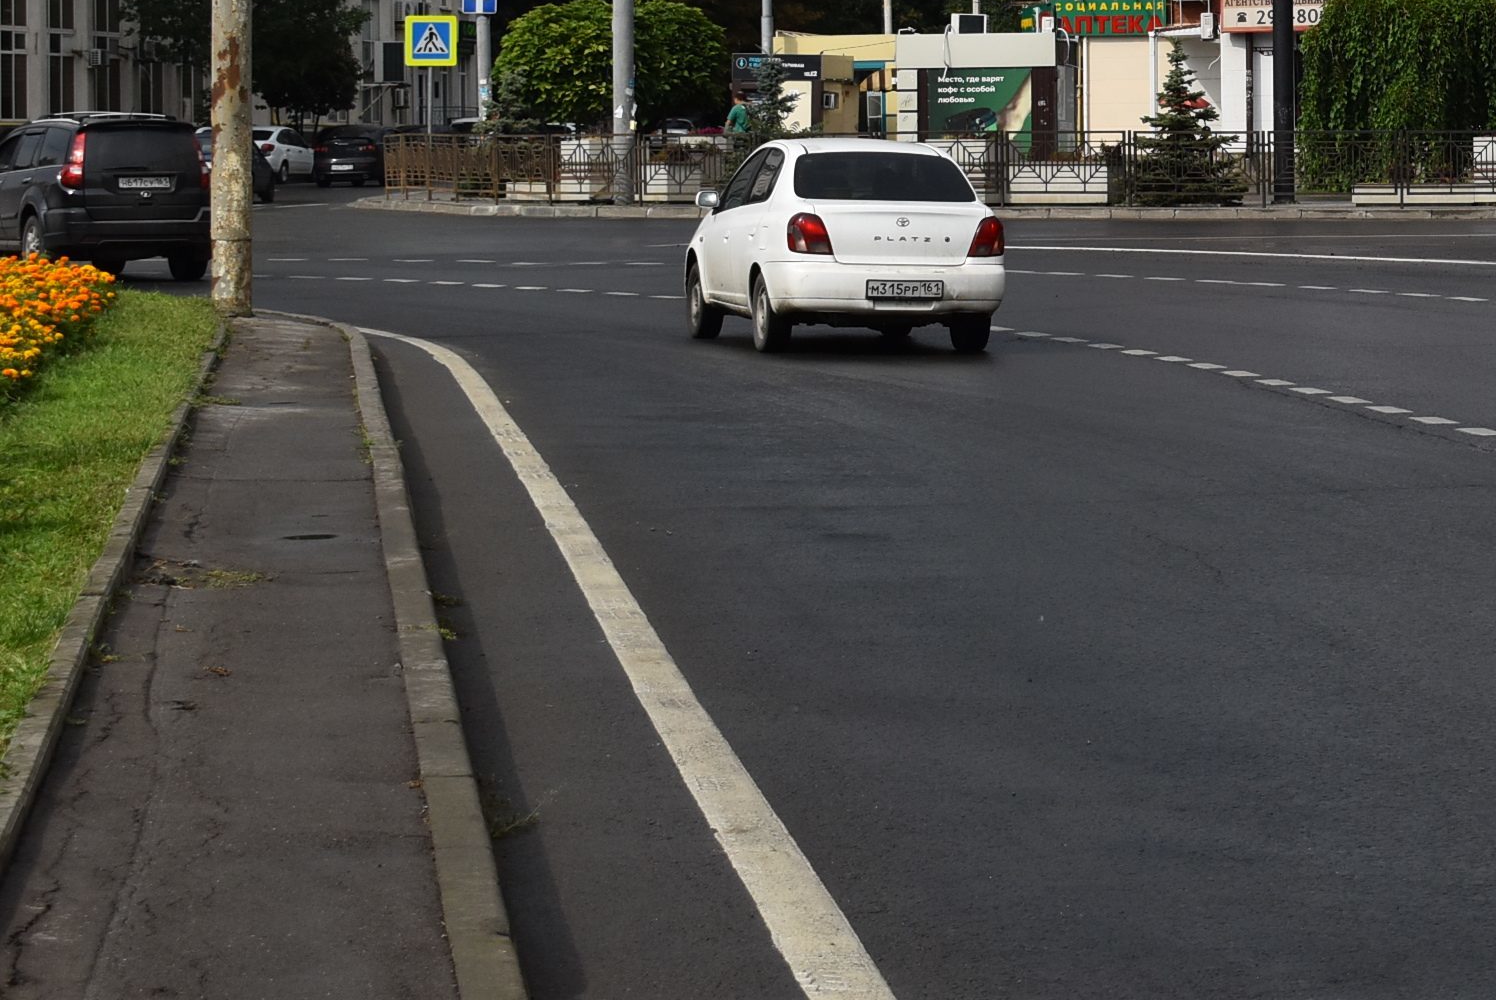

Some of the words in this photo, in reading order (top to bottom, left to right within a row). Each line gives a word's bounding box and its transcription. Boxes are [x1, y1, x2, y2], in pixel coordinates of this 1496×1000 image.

[1055, 1, 1164, 12] СОЦИАЛЬНАЯ
[1061, 14, 1163, 34] АПТЕКА
[937, 76, 965, 84] Место,
[937, 86, 958, 94] кофе
[966, 85, 996, 93] особой
[937, 96, 976, 104] любовью
